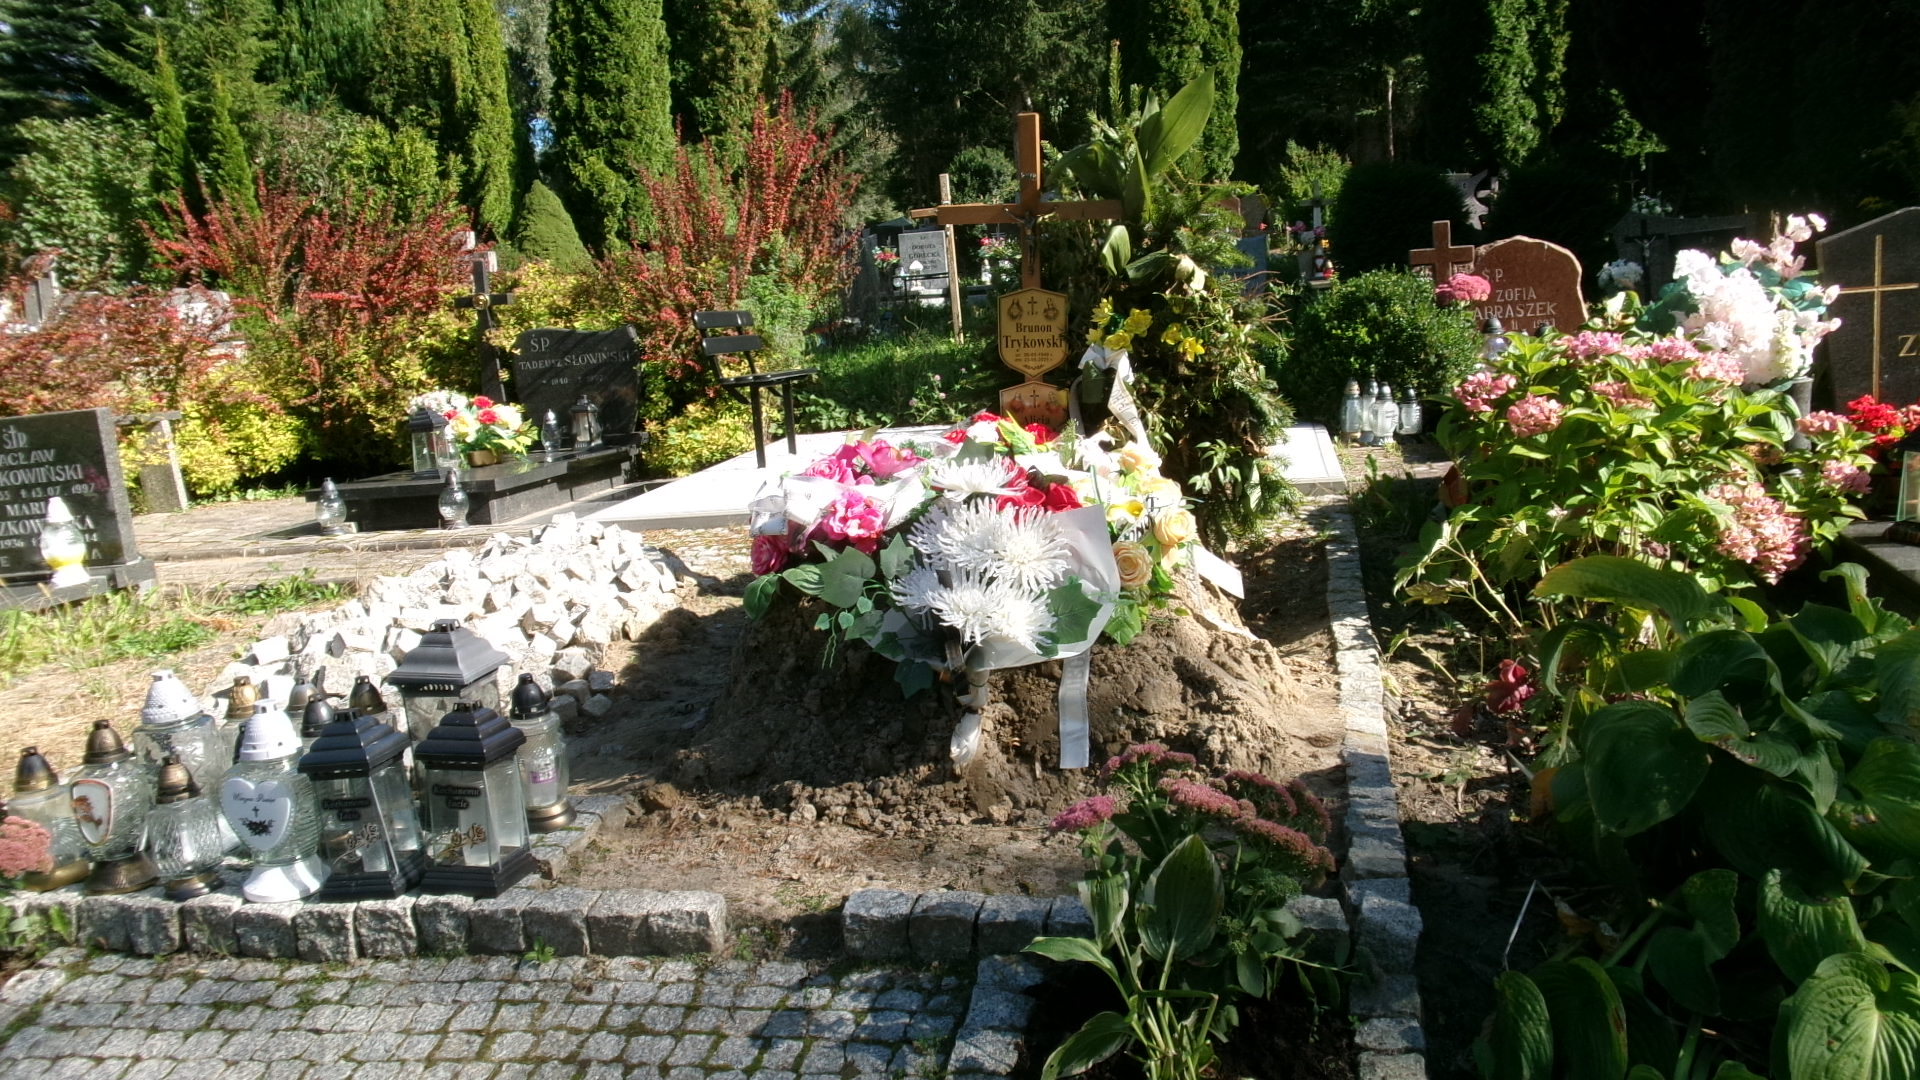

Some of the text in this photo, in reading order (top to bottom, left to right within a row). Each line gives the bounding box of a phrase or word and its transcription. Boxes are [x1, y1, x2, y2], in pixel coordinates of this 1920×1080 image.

[1496, 286, 1537, 303] ZOFIA
[1016, 322, 1052, 333] Brunon
[1003, 335, 1063, 350] Trykowski
[519, 347, 630, 370] TADEUSZ SŁOWIŃSKI
[6, 501, 47, 517] MARI
